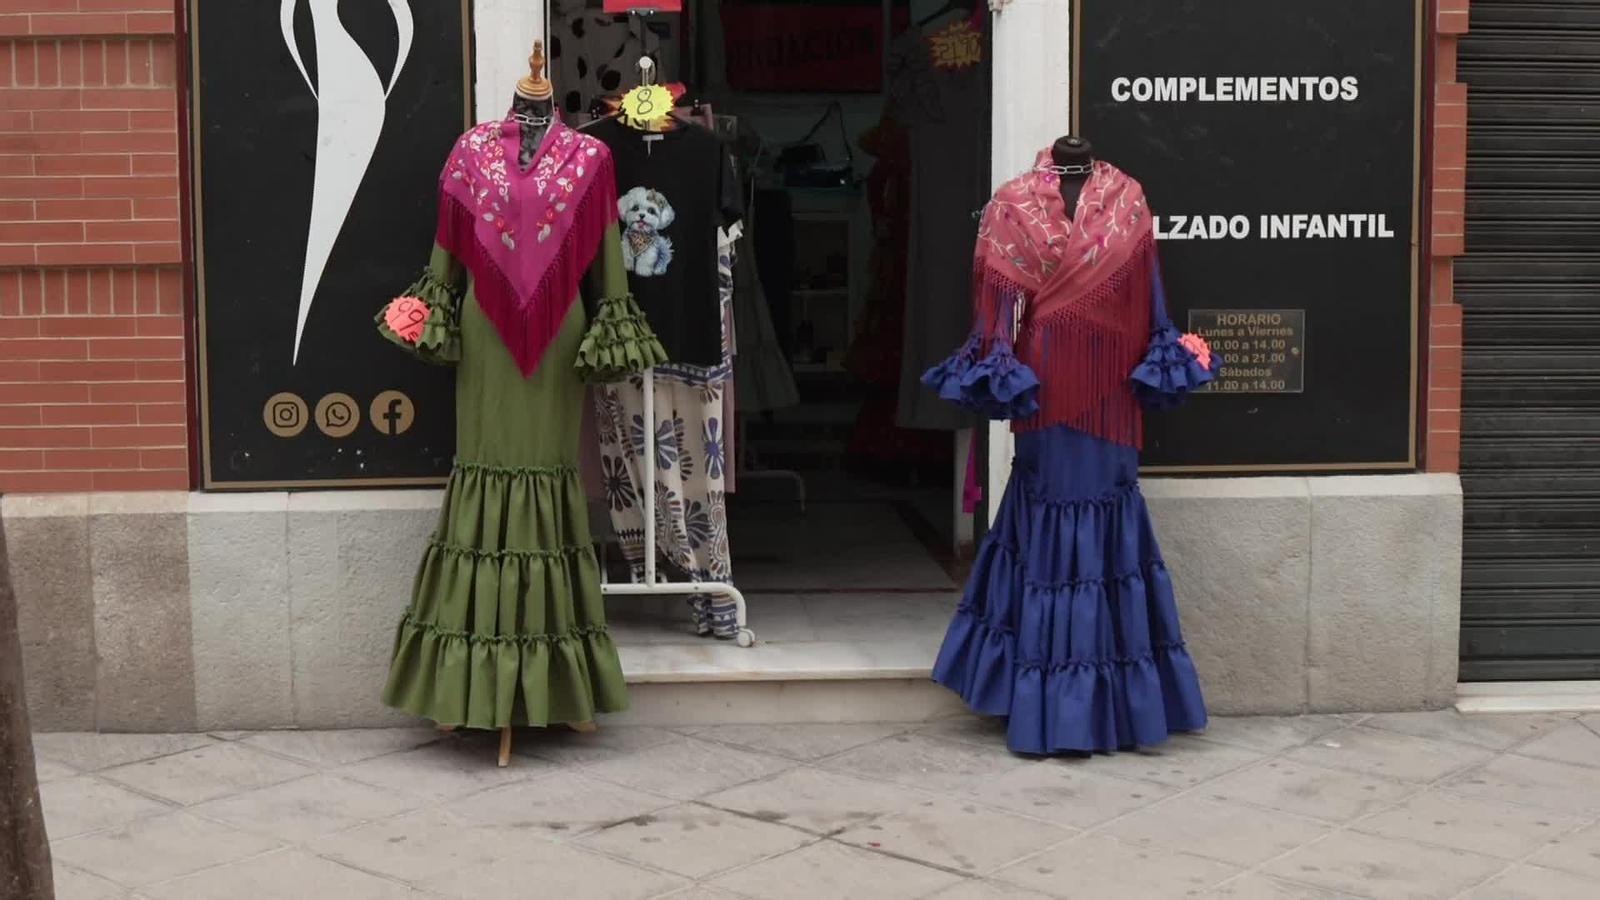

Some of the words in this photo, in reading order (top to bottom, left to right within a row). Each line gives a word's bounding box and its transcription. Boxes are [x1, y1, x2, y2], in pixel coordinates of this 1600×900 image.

[1111, 76, 1359, 102] COMPLEMENTOS
[636, 88, 654, 115] 8
[1153, 215, 1250, 240] LZADO
[1260, 213, 1394, 239] INFANTIL
[1217, 313, 1281, 325] HORARIO
[1198, 326, 1234, 337] Lunes
[1238, 329, 1245, 337] a
[1248, 326, 1294, 337] Viernes
[1241, 342, 1249, 350] a
[1253, 339, 1286, 350] 14.00
[1241, 355, 1249, 363] a
[1252, 353, 1286, 363] 21.00
[1219, 366, 1272, 377] Sábados
[1206, 380, 1239, 391] 11.00
[1241, 382, 1249, 390] a
[1253, 380, 1285, 390] 14.00
